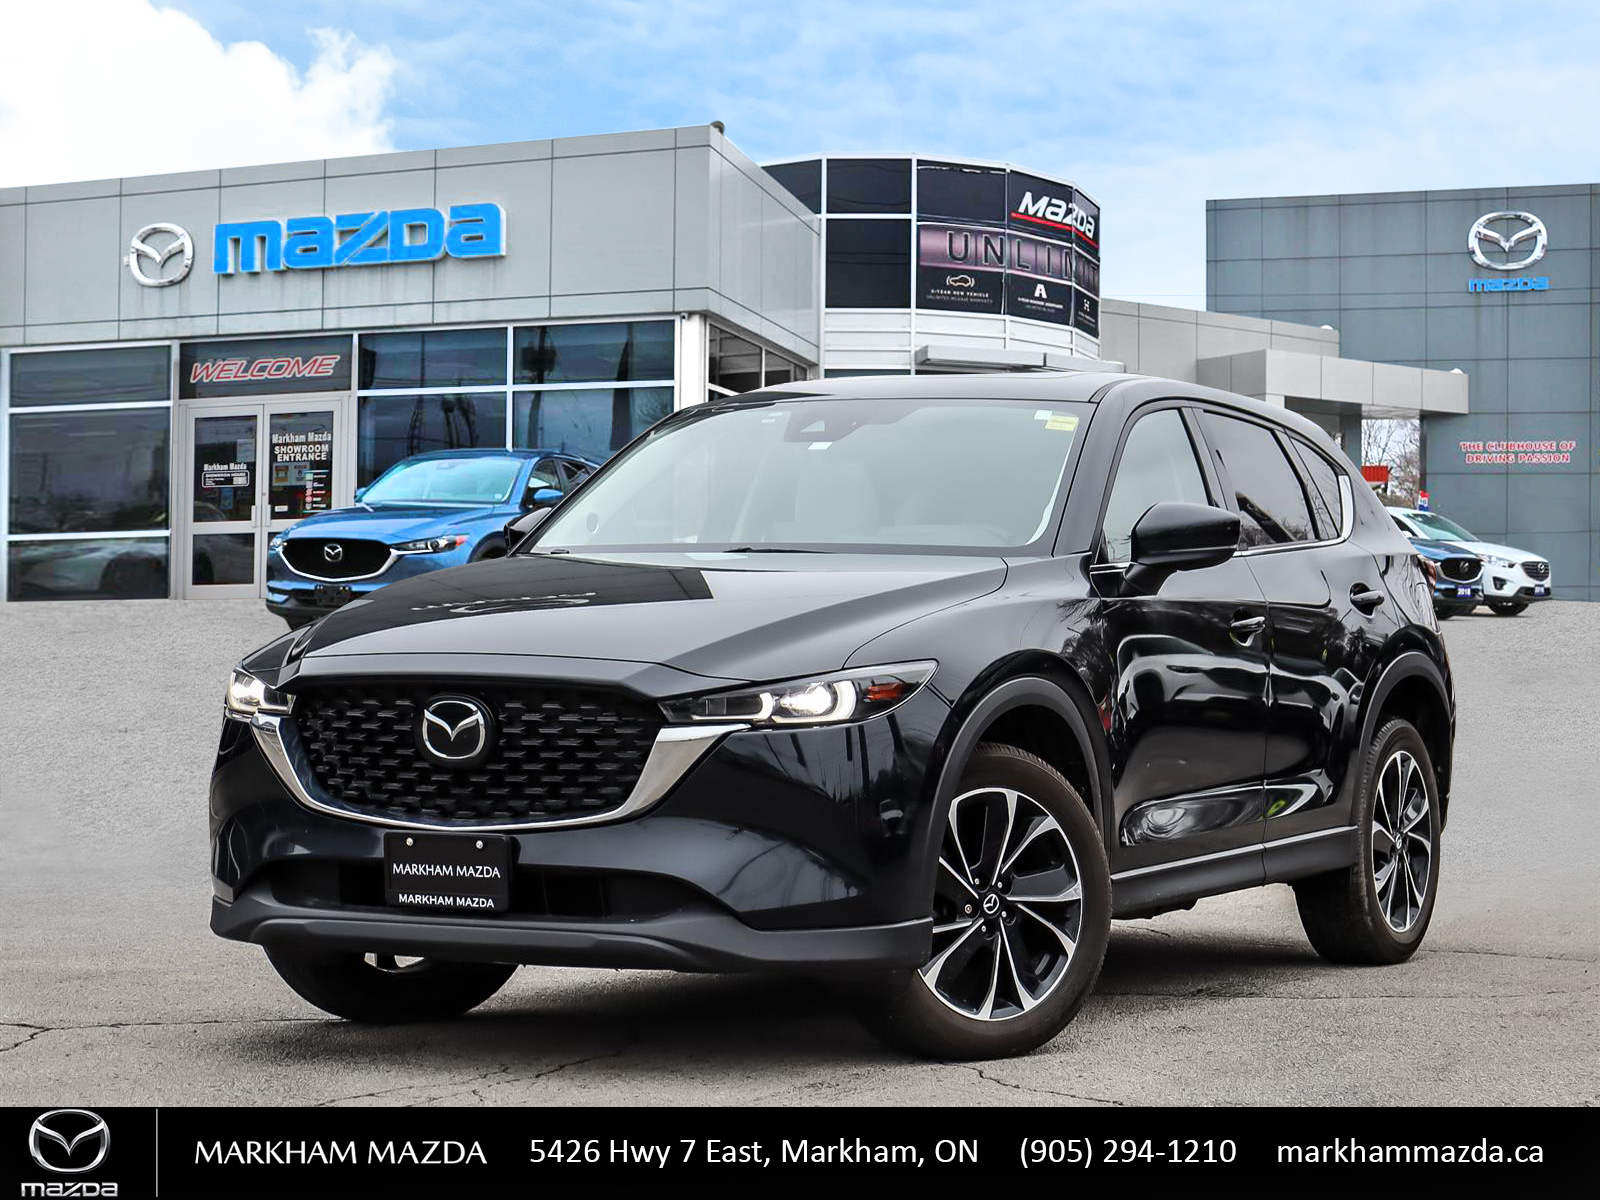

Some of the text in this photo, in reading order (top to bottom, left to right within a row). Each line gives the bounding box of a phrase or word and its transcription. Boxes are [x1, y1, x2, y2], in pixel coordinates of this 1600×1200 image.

[1018, 191, 1095, 239] Mazda
[190, 354, 341, 384] WELCOME
[272, 431, 332, 444] Markham Mazda
[274, 444, 329, 454] SHOWROOM
[1459, 440, 1577, 451] THE CLUBHOUSE OF
[277, 452, 327, 462] ENTRANCE
[1466, 453, 1571, 464] DRIVING PASSION
[203, 462, 228, 471] Markham
[393, 863, 501, 879] MARKHAM MAZDA
[398, 893, 495, 908] MARKHAM MAZDA
